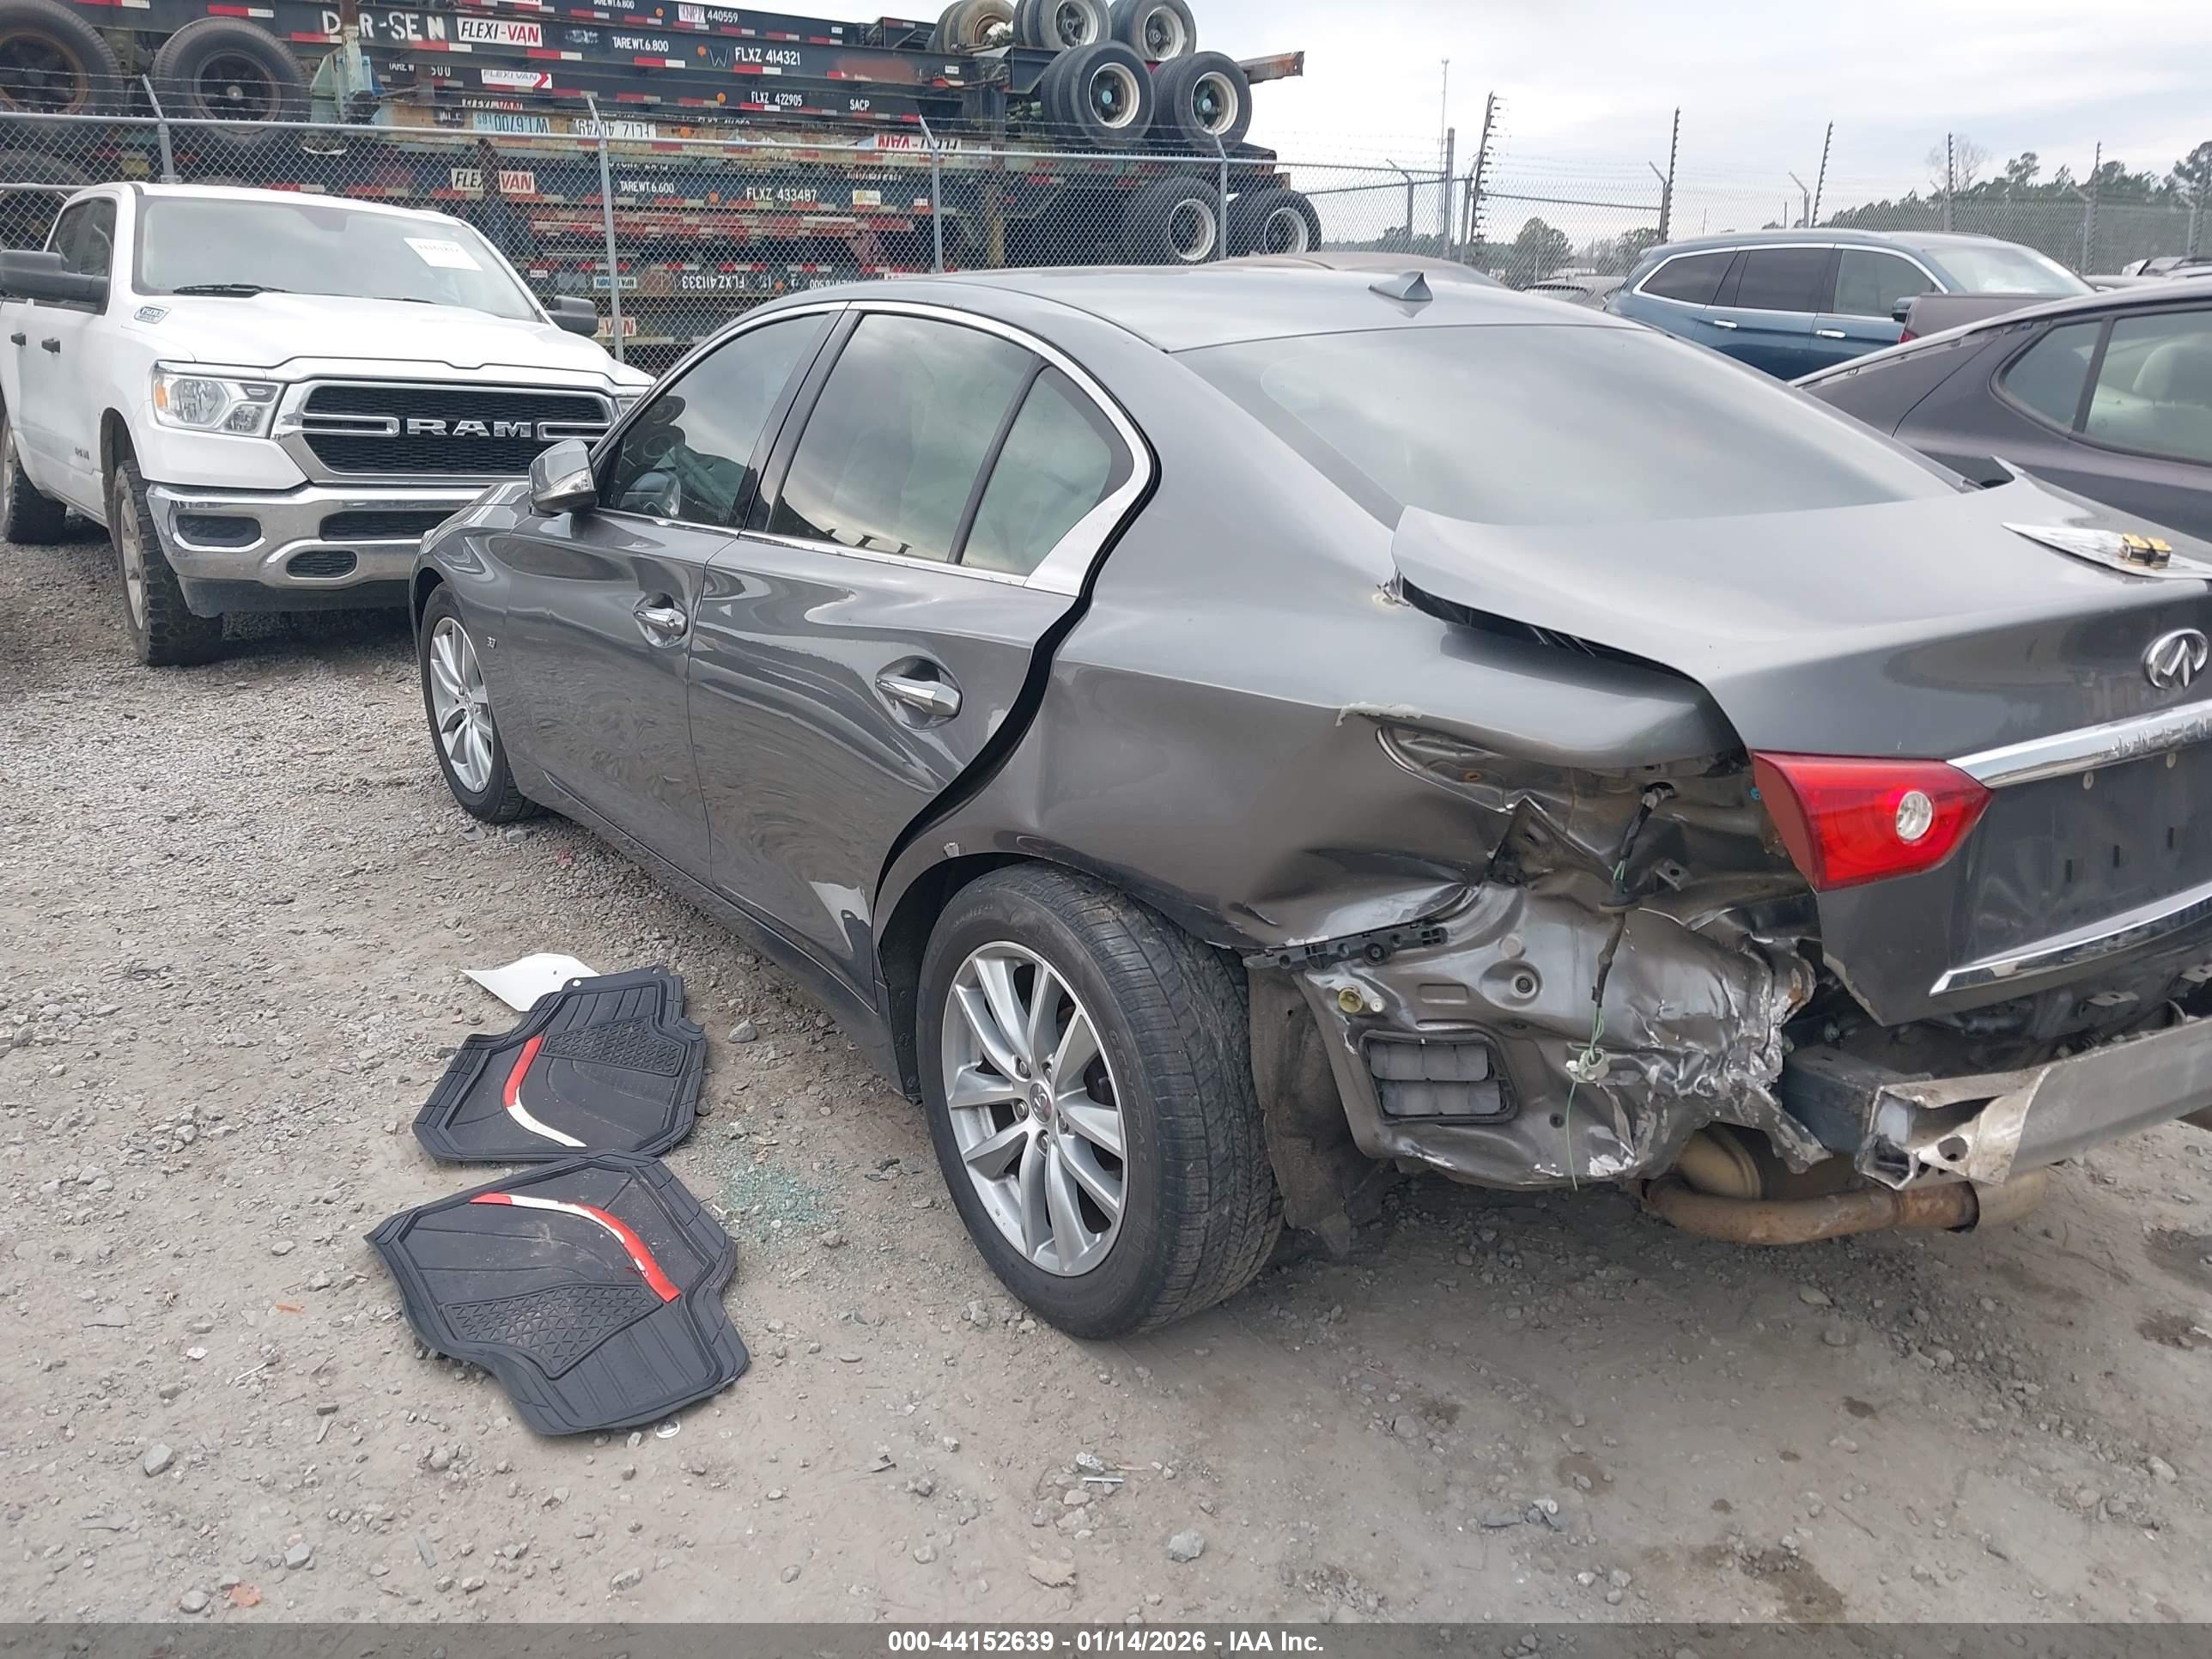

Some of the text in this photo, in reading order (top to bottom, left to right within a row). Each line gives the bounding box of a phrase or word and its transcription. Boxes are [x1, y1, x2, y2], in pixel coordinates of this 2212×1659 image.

[708, 9, 738, 23] 440559
[460, 20, 539, 43] FLEXI-VAN
[735, 46, 801, 66] FLXZ 414321
[750, 91, 870, 111] FLXZ 422905 SACP
[746, 186, 817, 203] FLXZ 433487
[406, 417, 532, 438] RAM
